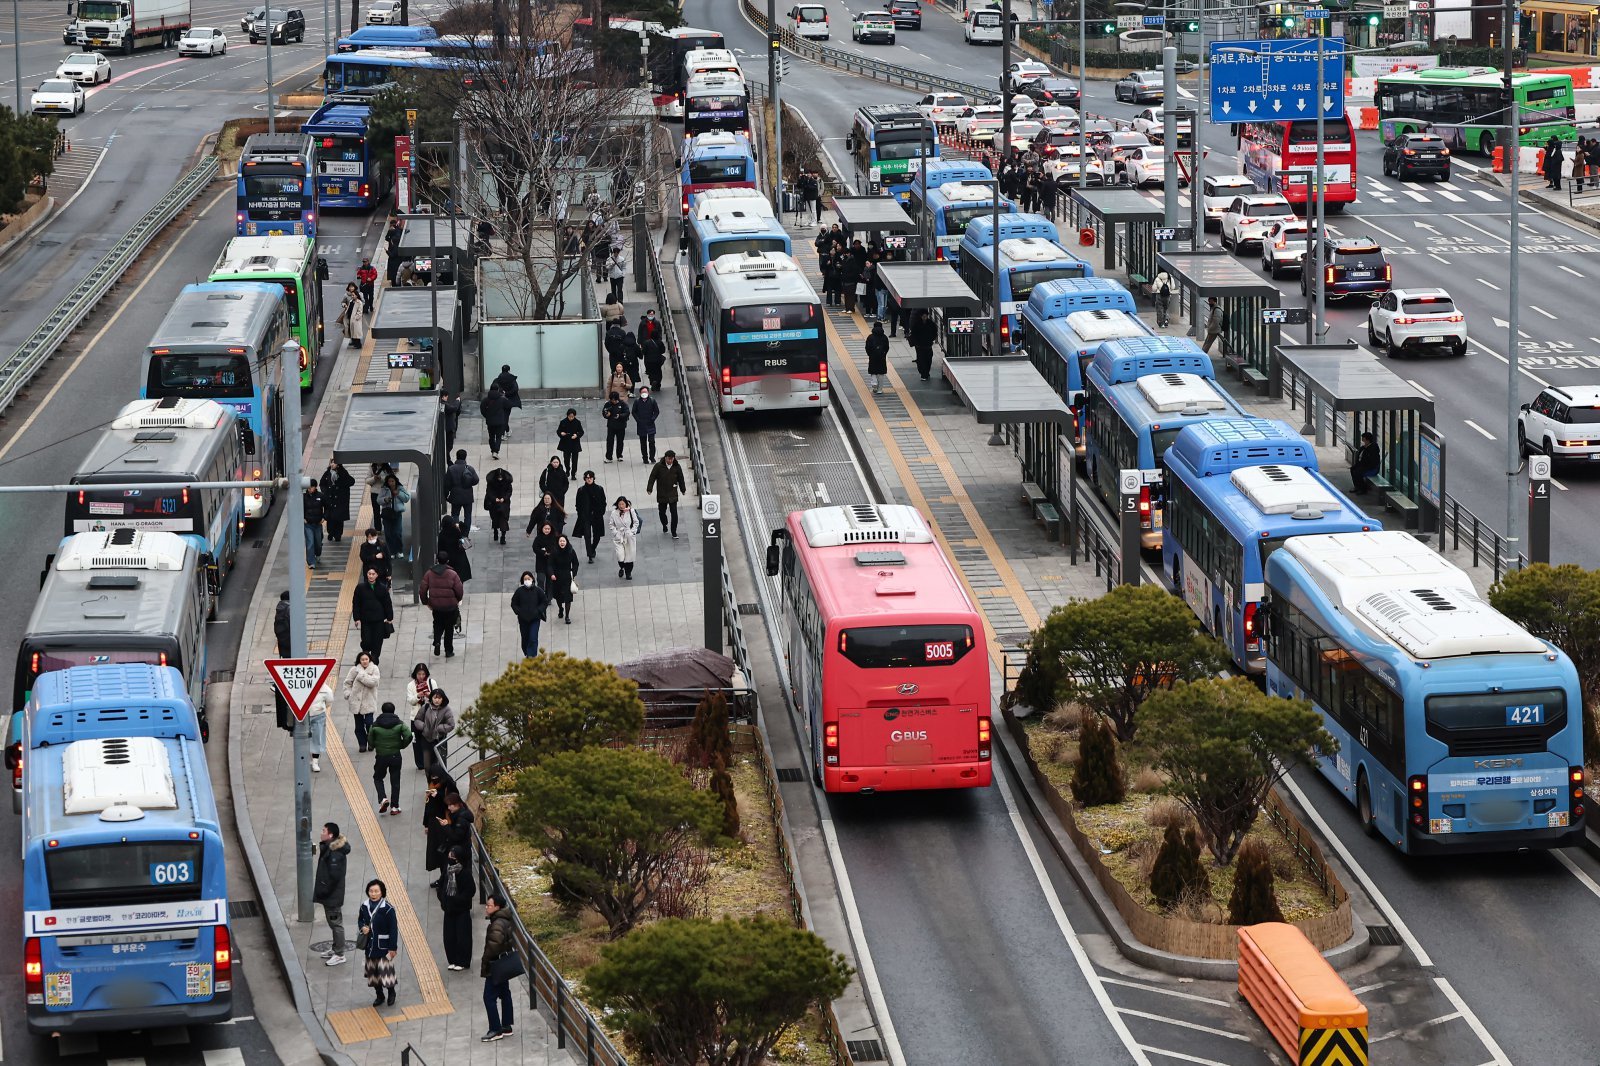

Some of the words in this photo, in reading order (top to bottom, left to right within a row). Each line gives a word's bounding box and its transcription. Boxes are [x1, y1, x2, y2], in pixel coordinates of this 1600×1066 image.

[1217, 86, 1237, 95] 1차로
[1267, 84, 1287, 93] 3차로
[1291, 83, 1311, 92] 4차로
[1317, 82, 1338, 91] 차로
[344, 152, 356, 160] 709
[726, 166, 740, 175] 104
[1107, 175, 1113, 184] 4
[873, 183, 878, 191] 5
[1537, 483, 1546, 495] 4
[1127, 497, 1136, 509] 5
[707, 522, 716, 535] 6
[926, 643, 953, 658] 5005
[282, 666, 317, 679] 천천히
[287, 679, 313, 690] SLOW
[1511, 705, 1540, 724] 421
[1530, 788, 1558, 797] 삼성여객
[154, 862, 190, 884] 603
[111, 943, 147, 954] 중부운수
[187, 966, 200, 977] 주의
[58, 975, 71, 985] 주의
